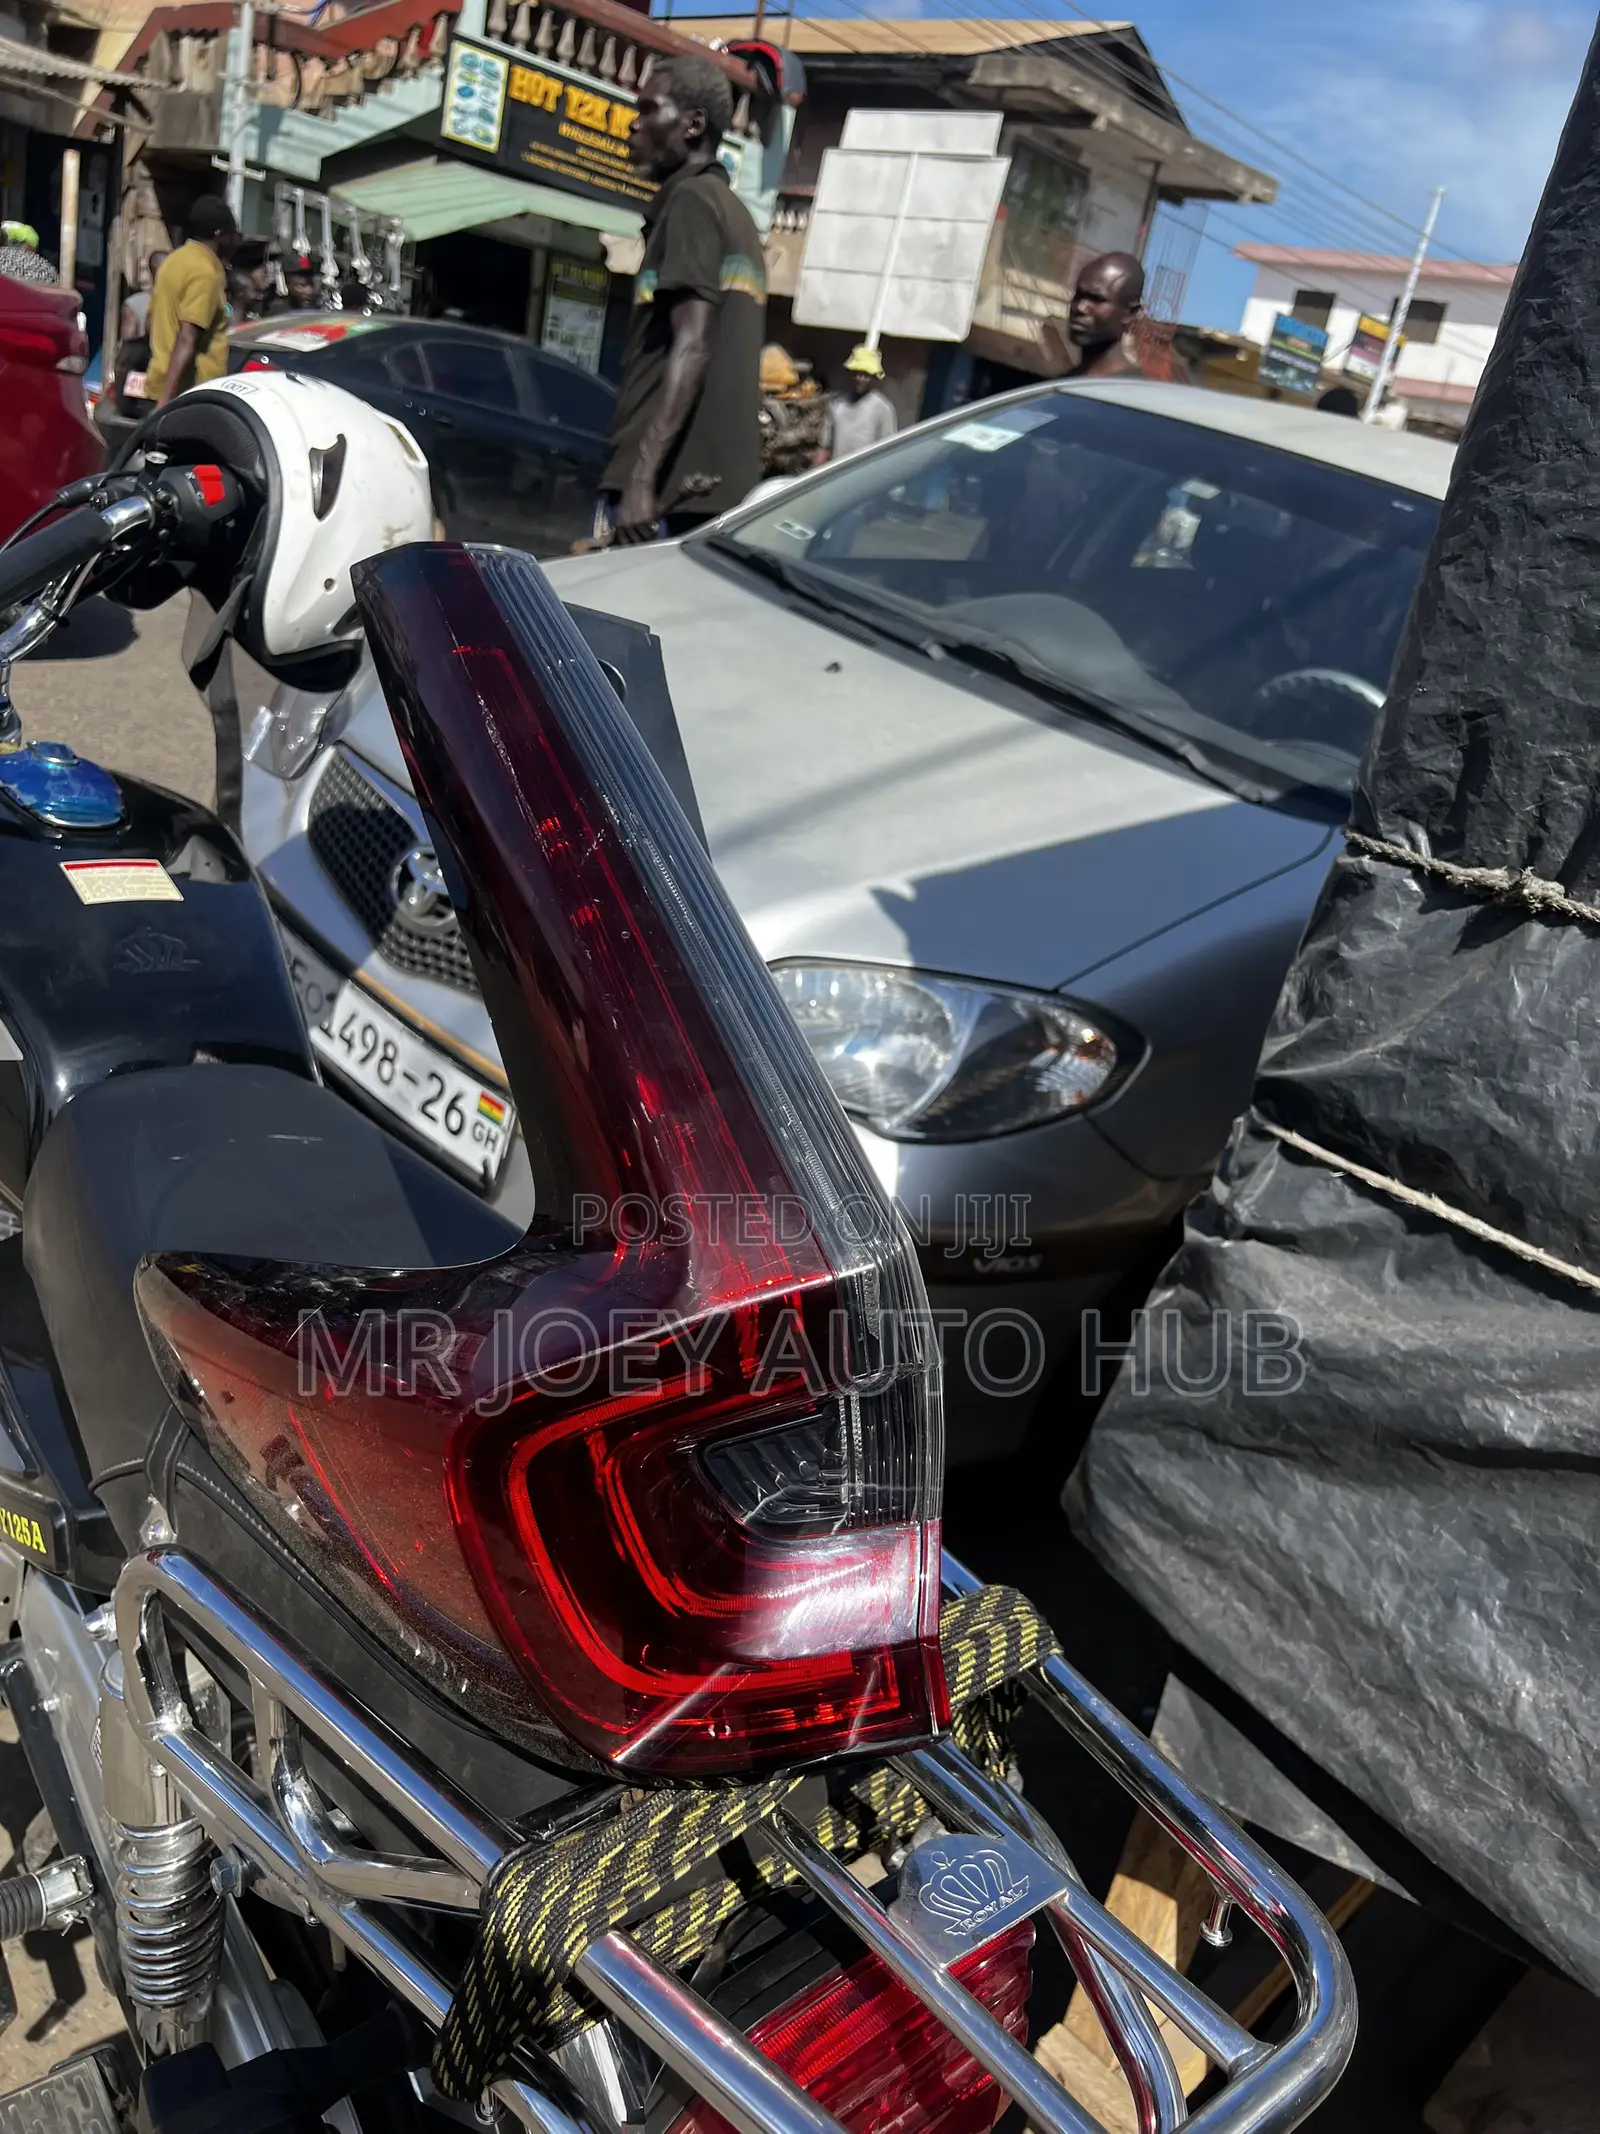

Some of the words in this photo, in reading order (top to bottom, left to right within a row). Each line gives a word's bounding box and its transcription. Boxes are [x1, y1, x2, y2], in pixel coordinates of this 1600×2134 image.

[509, 64, 564, 113] HOT
[472, 1121, 499, 1152] GH
[960, 1888, 1023, 1932] ROYAL
